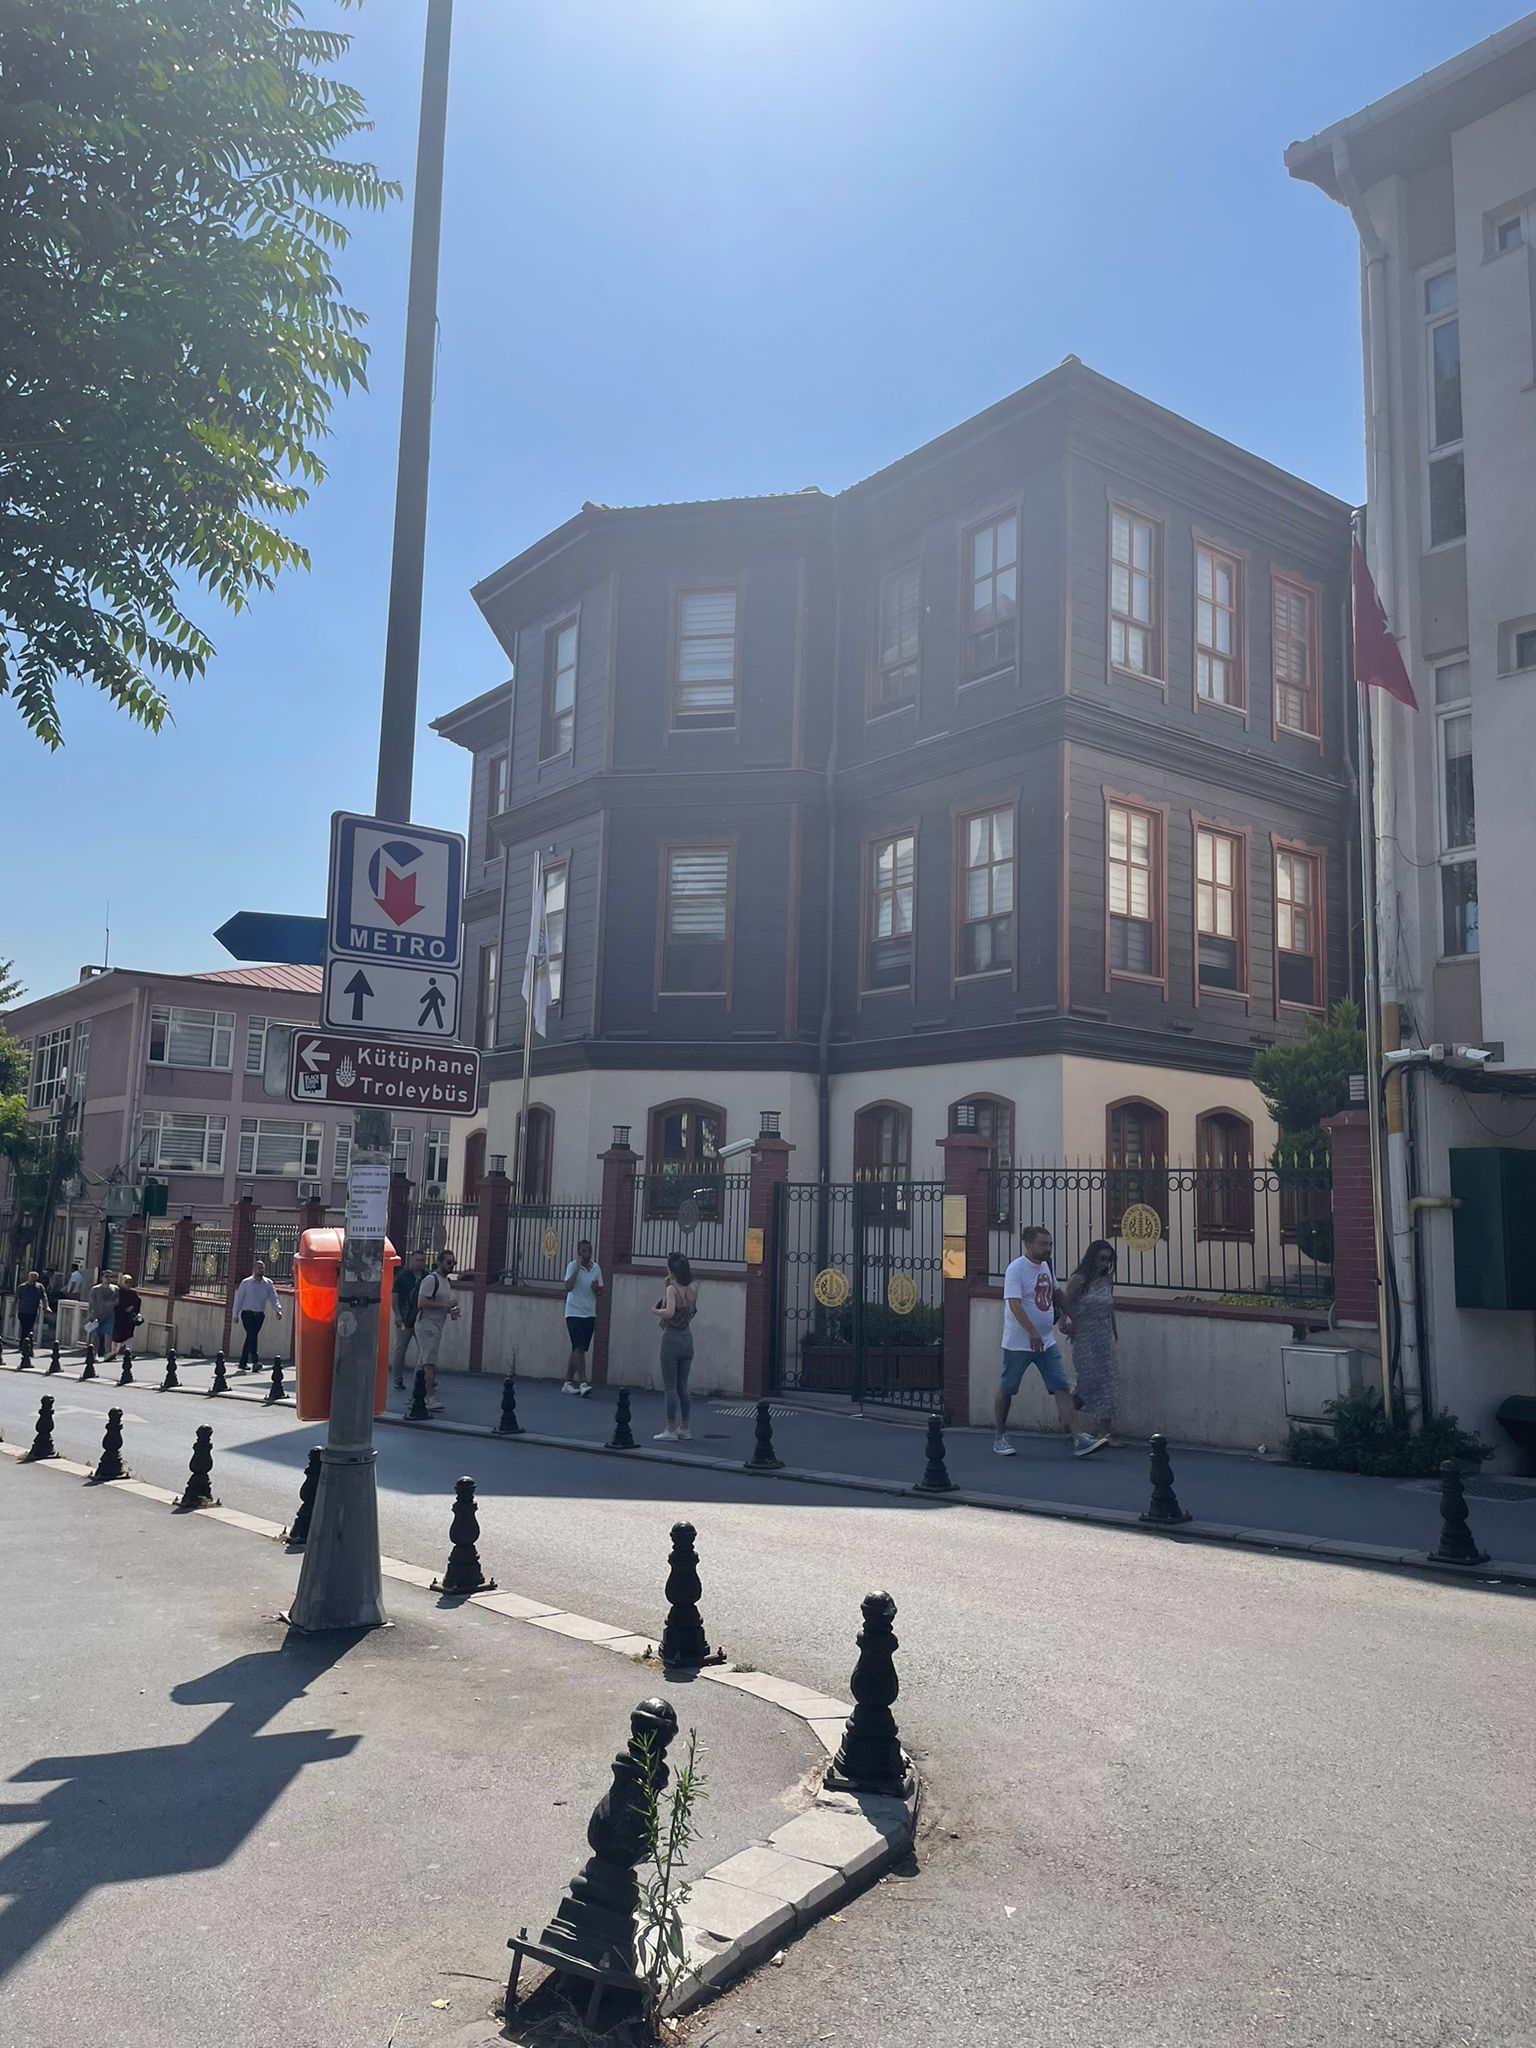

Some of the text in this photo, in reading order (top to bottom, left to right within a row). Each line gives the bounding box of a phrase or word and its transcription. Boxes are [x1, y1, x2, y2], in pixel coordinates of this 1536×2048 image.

[350, 928, 446, 959] METRO
[357, 1047, 475, 1076] Kütüphane
[360, 1077, 468, 1103] Troleybüs
